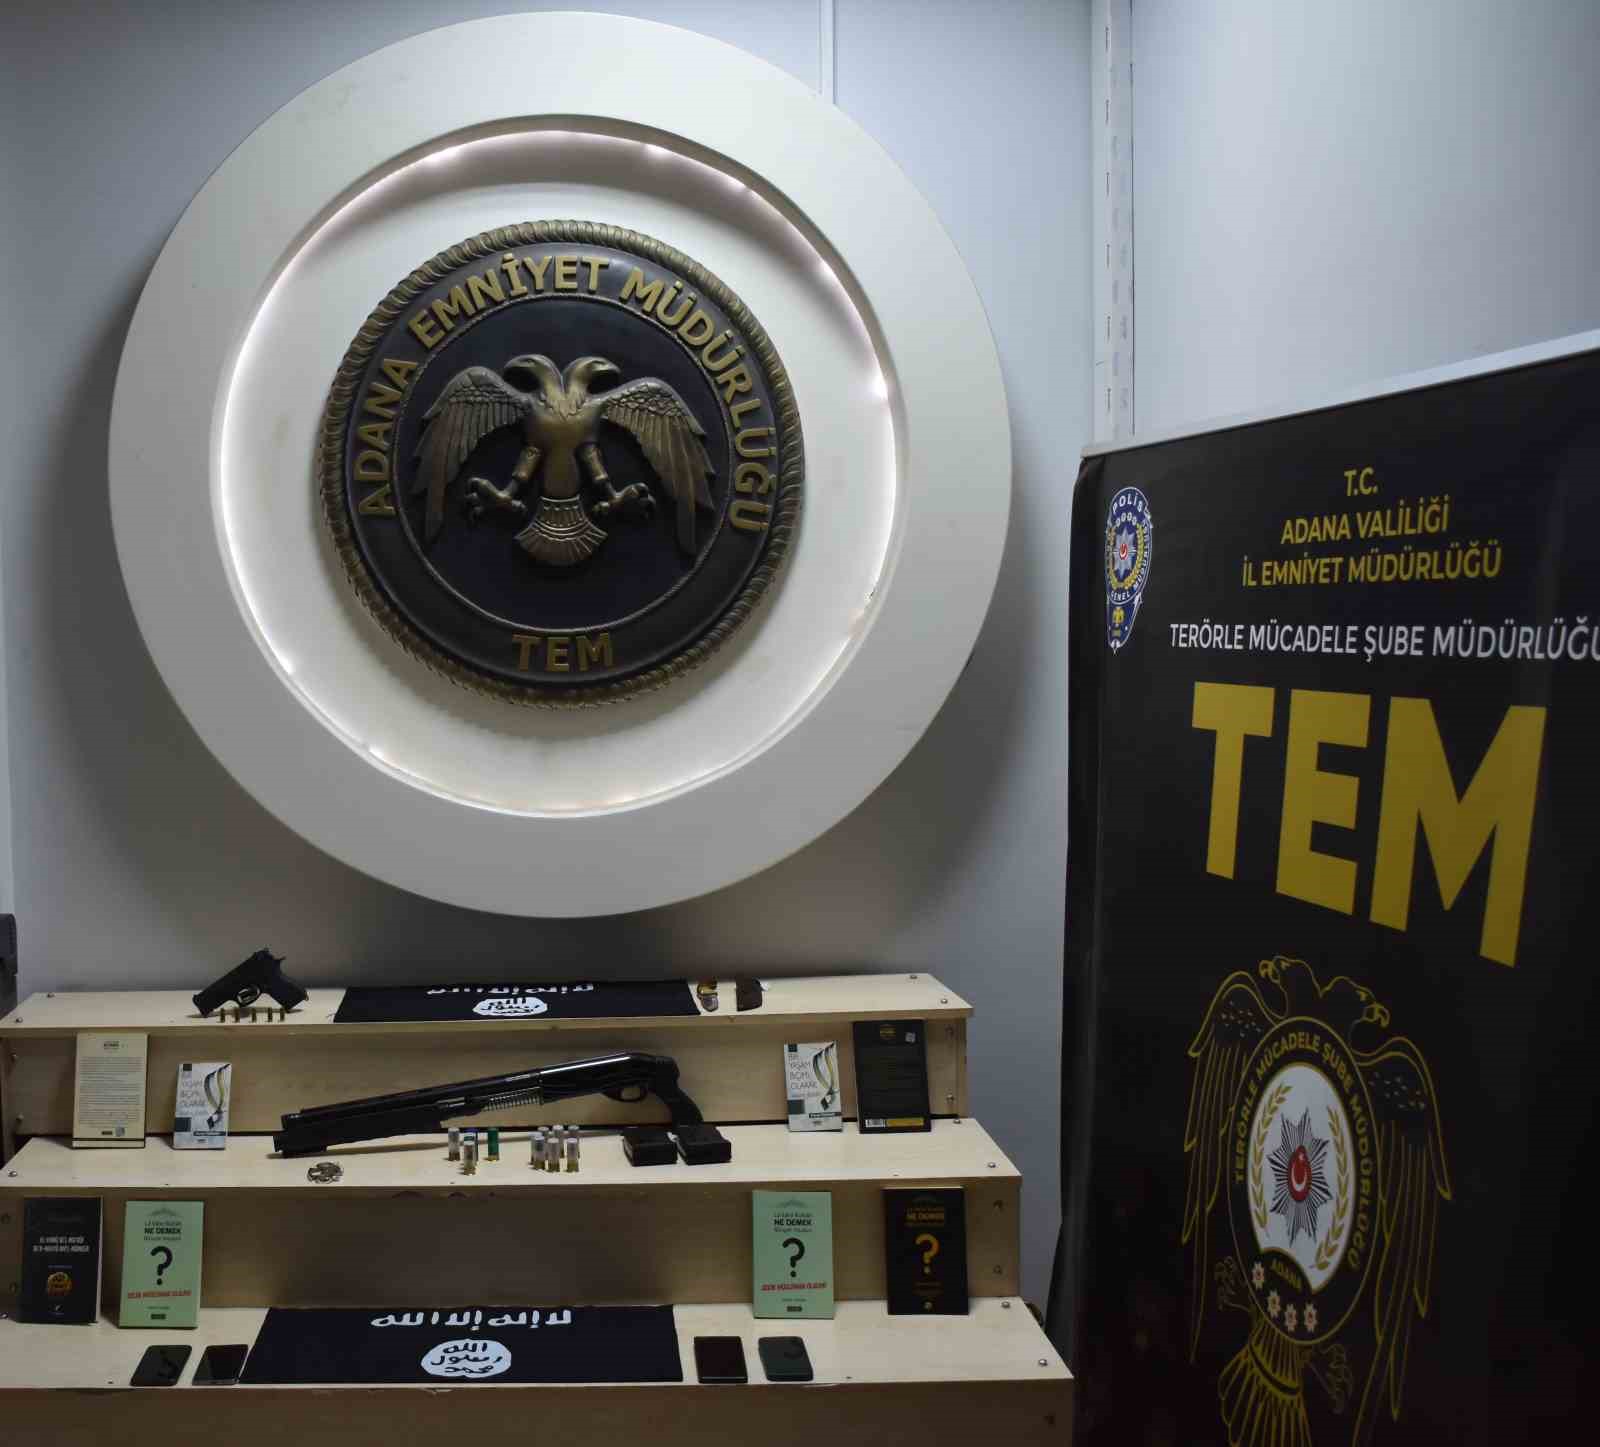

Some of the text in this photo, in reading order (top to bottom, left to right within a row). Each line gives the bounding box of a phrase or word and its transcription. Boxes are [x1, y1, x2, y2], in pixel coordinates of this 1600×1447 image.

[355, 252, 777, 533] ADANA EMNİYET MÜDÜRLÜĞÜ
[1344, 467, 1378, 496] T.C.
[1112, 493, 1143, 515] POLİS
[1280, 493, 1450, 544] ADANA VALİLİĞİ
[1242, 539, 1502, 586] İL EMNİYET MÜDÜRLÜĞÜ
[512, 632, 615, 673] TEM
[1170, 618, 1244, 650] TERÖRLE
[1248, 619, 1358, 654] MÜCADELE
[1363, 626, 1425, 663] ŞUBE
[1191, 680, 1547, 968] TEM
[150, 1246, 173, 1286] ?
[782, 1237, 805, 1278] ?
[915, 1233, 940, 1274] ?
